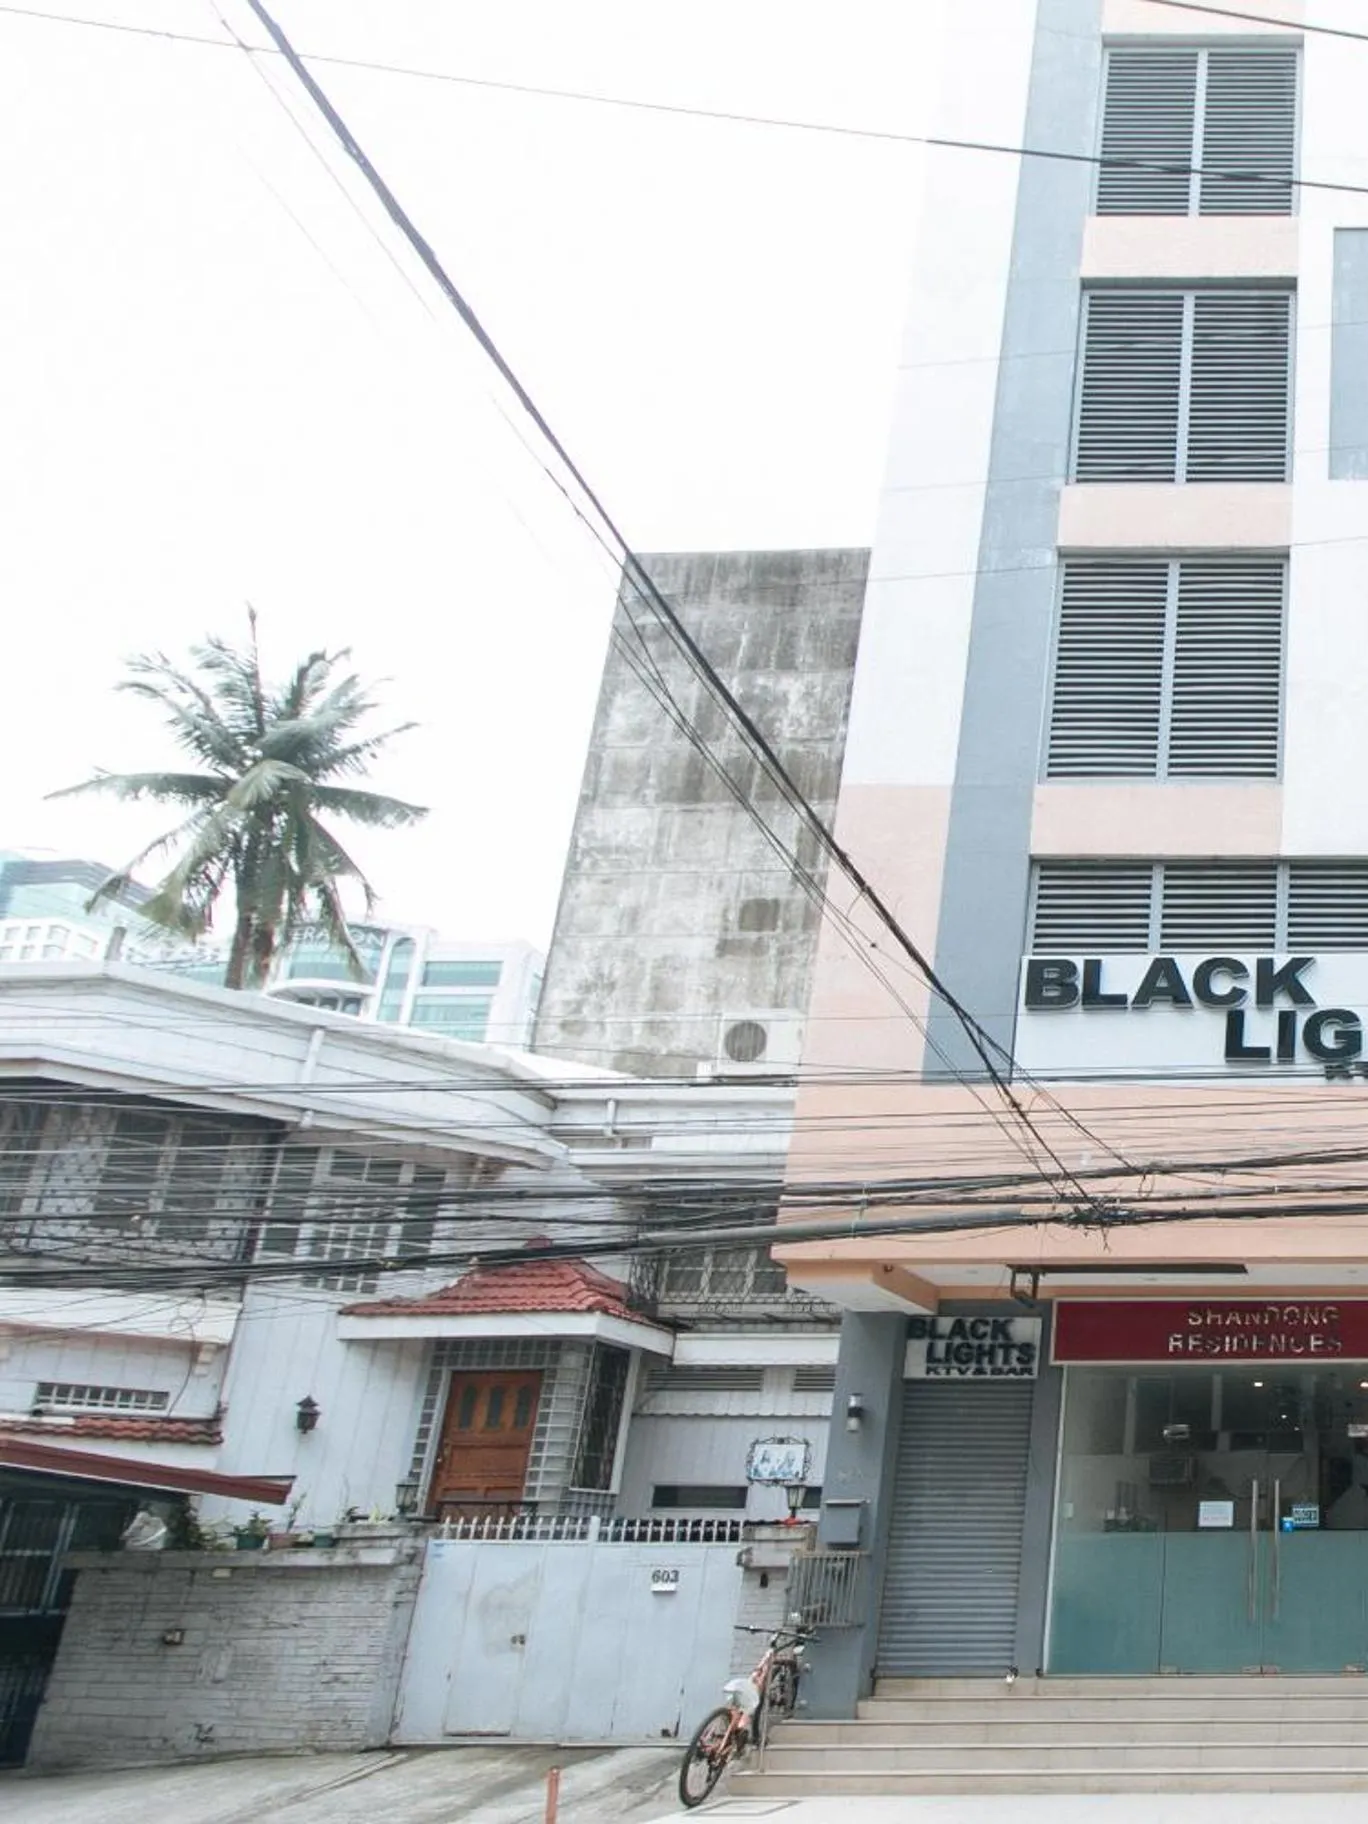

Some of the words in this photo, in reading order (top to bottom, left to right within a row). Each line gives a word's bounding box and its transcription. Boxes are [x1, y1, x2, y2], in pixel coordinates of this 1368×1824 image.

[1025, 957, 1317, 1011] BLACK
[907, 1318, 1014, 1341] BLACK
[926, 1342, 1036, 1365] LIGHTS
[1168, 1333, 1342, 1353] RESIDENCES
[651, 1569, 680, 1584] 603
